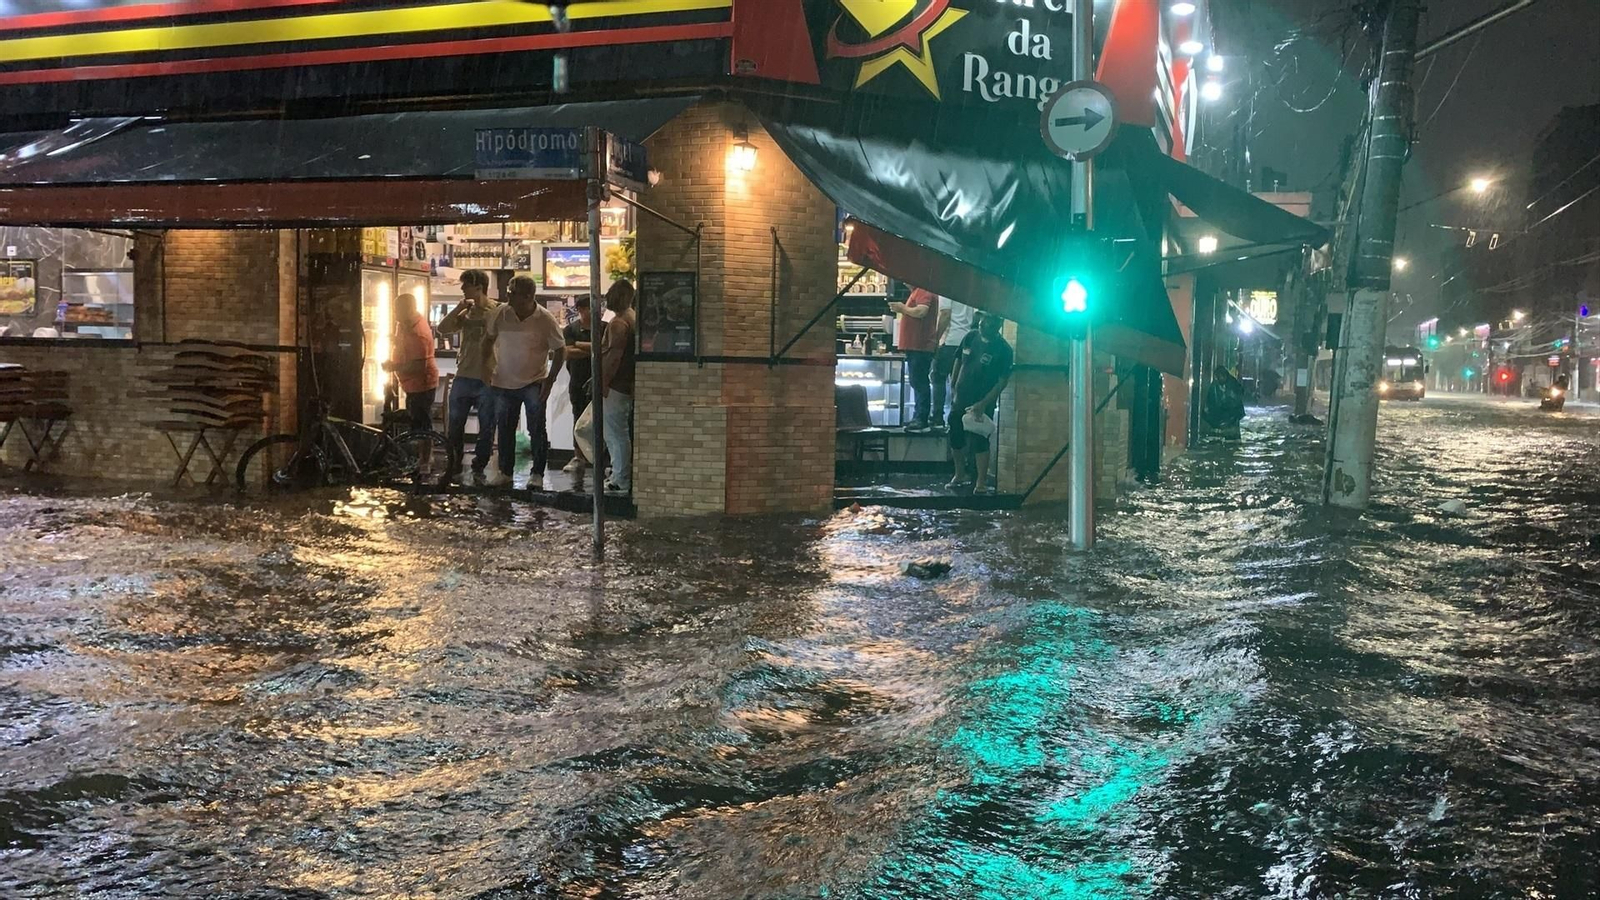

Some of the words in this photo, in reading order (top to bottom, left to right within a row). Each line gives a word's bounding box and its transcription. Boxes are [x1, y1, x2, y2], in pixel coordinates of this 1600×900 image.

[1008, 18, 1052, 60] da
[963, 52, 1071, 111] Rang
[475, 130, 577, 154] Hipódromo
